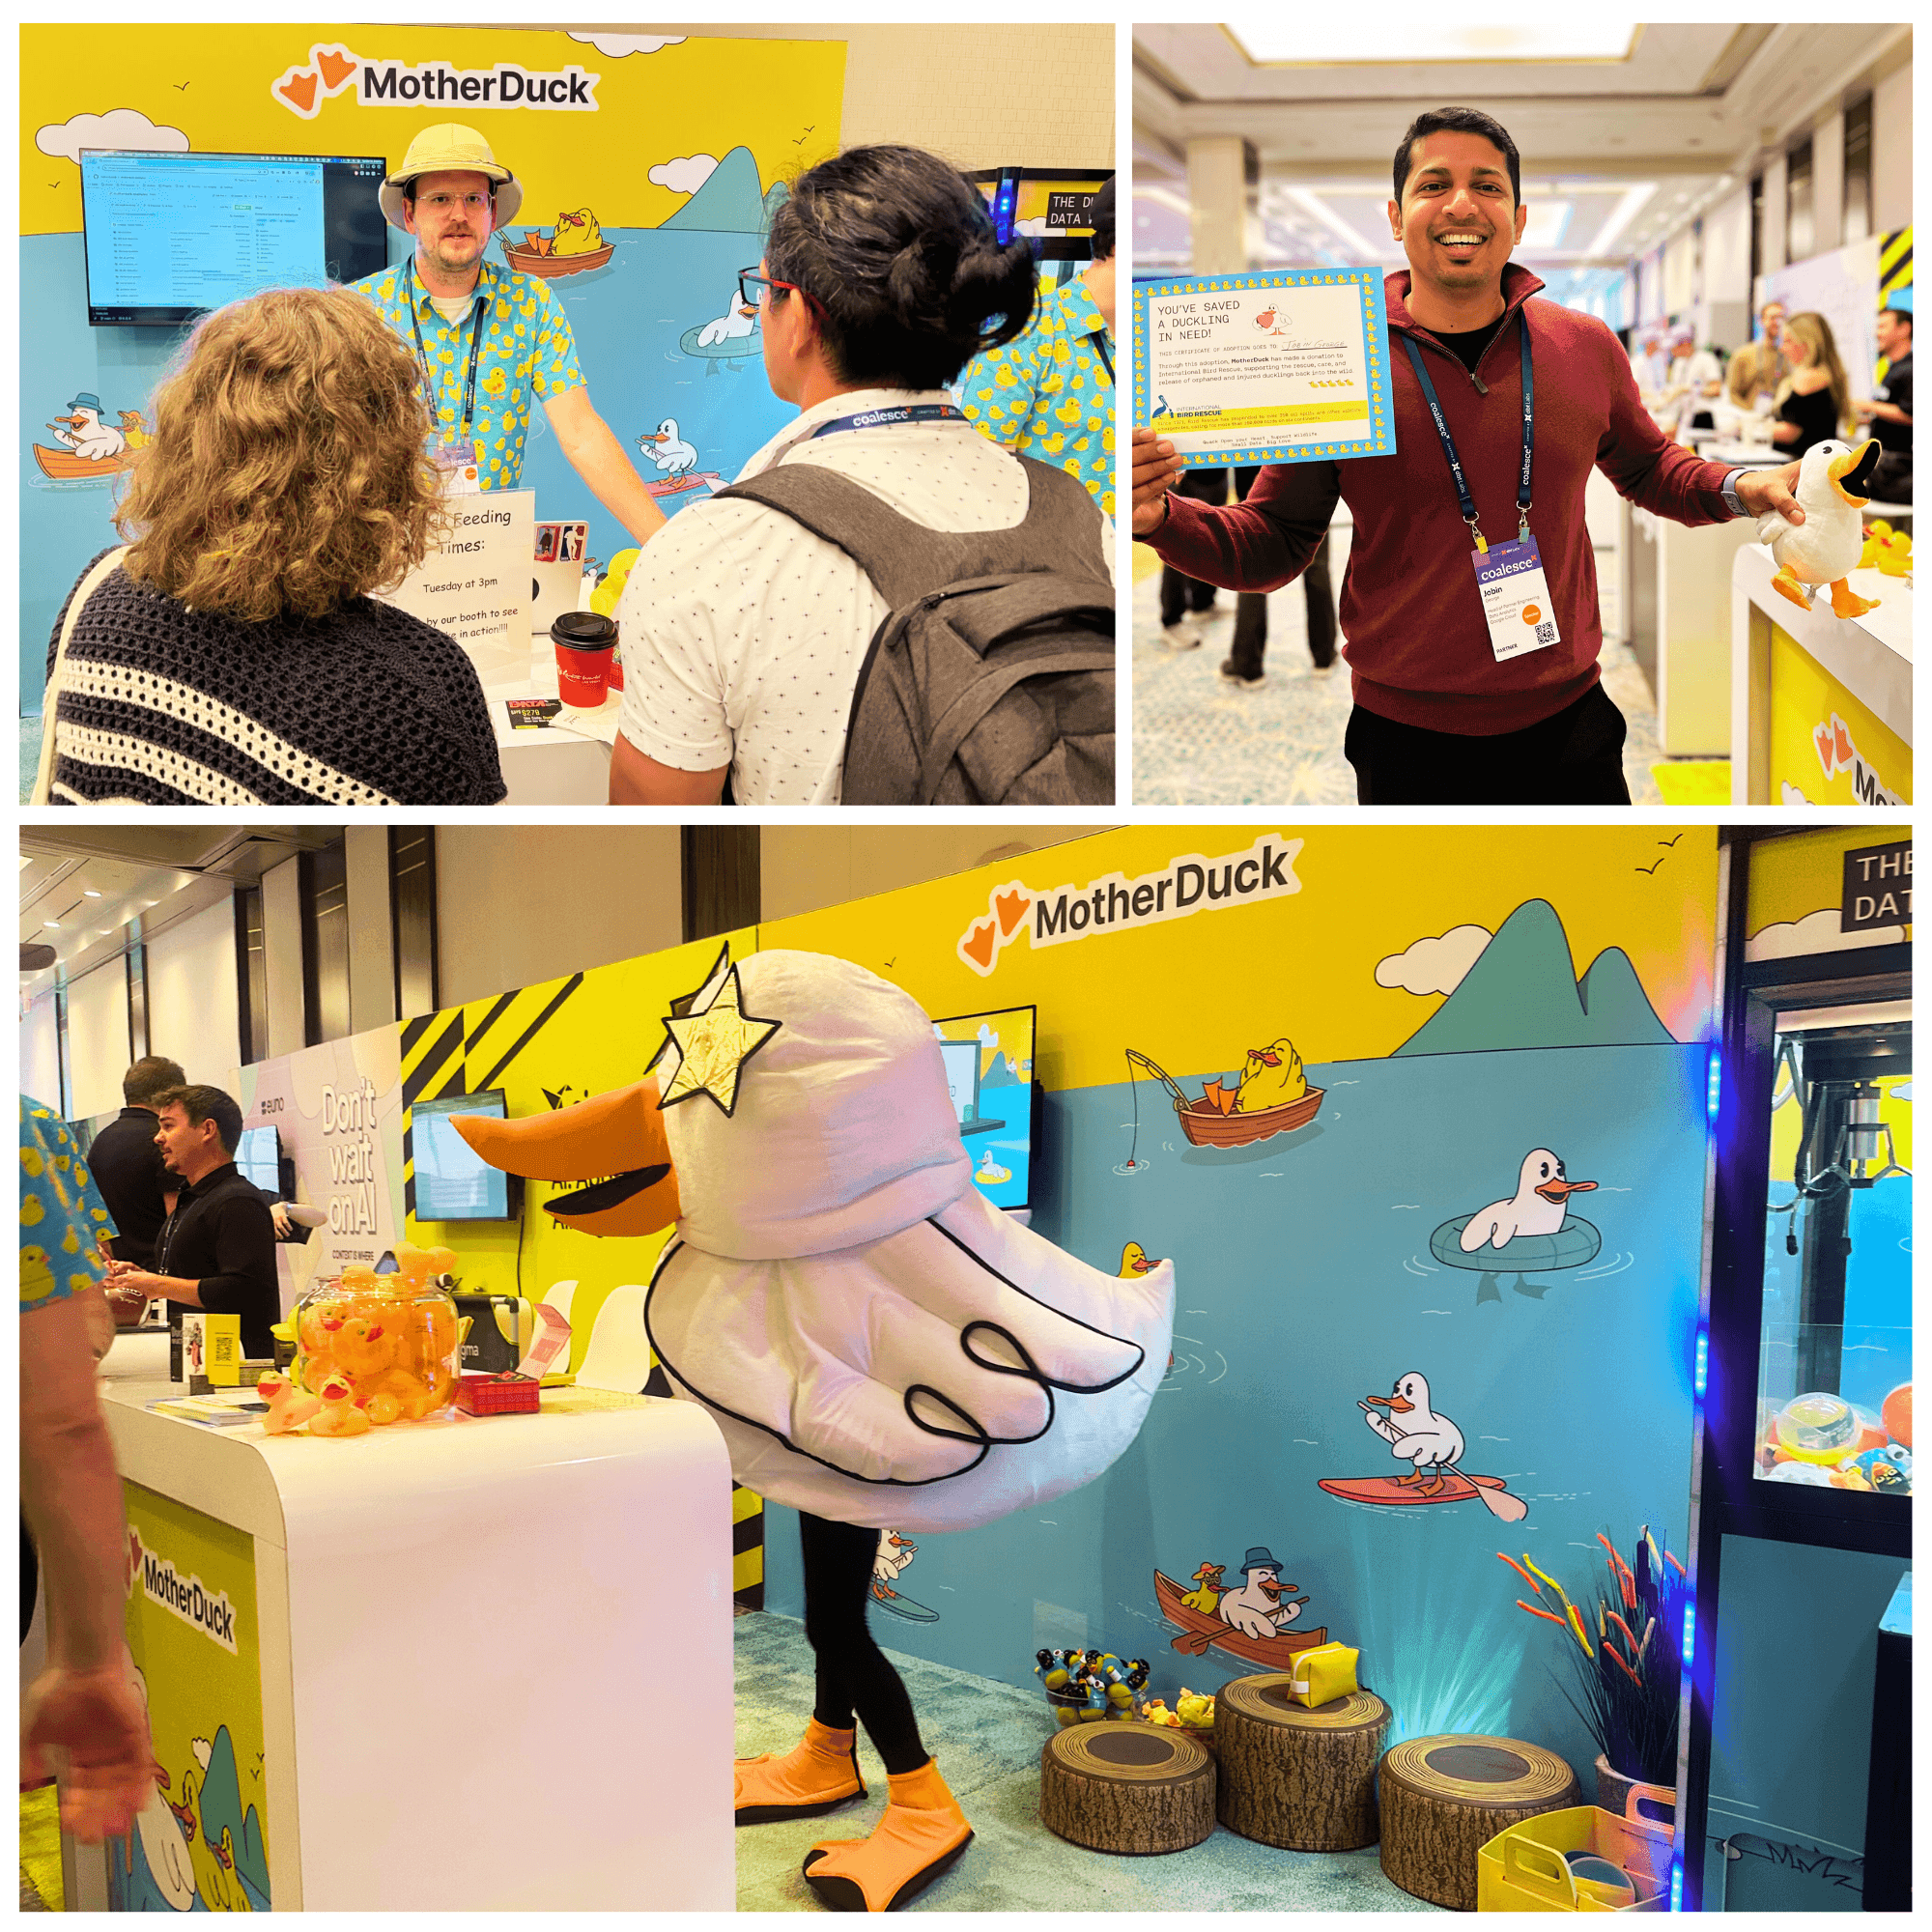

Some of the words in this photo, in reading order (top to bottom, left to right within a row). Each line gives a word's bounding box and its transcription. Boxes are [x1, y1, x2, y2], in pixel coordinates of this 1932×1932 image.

[364, 67, 590, 104] MotherDuck
[1053, 196, 1075, 208] THE
[1083, 196, 1094, 208] D
[1050, 213, 1081, 224] DATA
[1157, 303, 1196, 315] YOU'VE
[1204, 300, 1240, 311] SAVED
[1158, 320, 1165, 329] A
[1172, 315, 1229, 327] DUCKLING
[1159, 332, 1172, 342] IN
[1179, 328, 1211, 340] NEED!
[1159, 369, 1201, 377] International
[852, 410, 908, 427] coalesce
[1430, 402, 1447, 437] coalesce
[1522, 449, 1531, 485] coalesce
[453, 509, 512, 528] Feeding
[437, 541, 485, 554] Times:
[1481, 558, 1533, 581] coalesce
[423, 582, 462, 593] Tuesday
[465, 580, 475, 588] at
[478, 578, 497, 588] 3pm
[1484, 586, 1502, 597] Jobin
[1517, 595, 1540, 605] Engineering
[426, 618, 438, 627] by
[441, 616, 457, 624] our
[460, 611, 487, 622] booth
[490, 610, 500, 618] to
[502, 608, 518, 616] see
[459, 629, 468, 638] in
[469, 623, 508, 638] action!!!!
[1496, 643, 1518, 653] PARTNER
[1037, 845, 1289, 939] MotherDuck
[267, 1097, 284, 1115] euno
[323, 1076, 377, 1135] Don't
[328, 1132, 373, 1184] wait
[332, 1250, 352, 1260] CONTEXT
[352, 1250, 357, 1260] IS
[357, 1251, 374, 1261] WHERE
[460, 1343, 479, 1360] gma
[145, 1555, 233, 1643] MotherDuck
